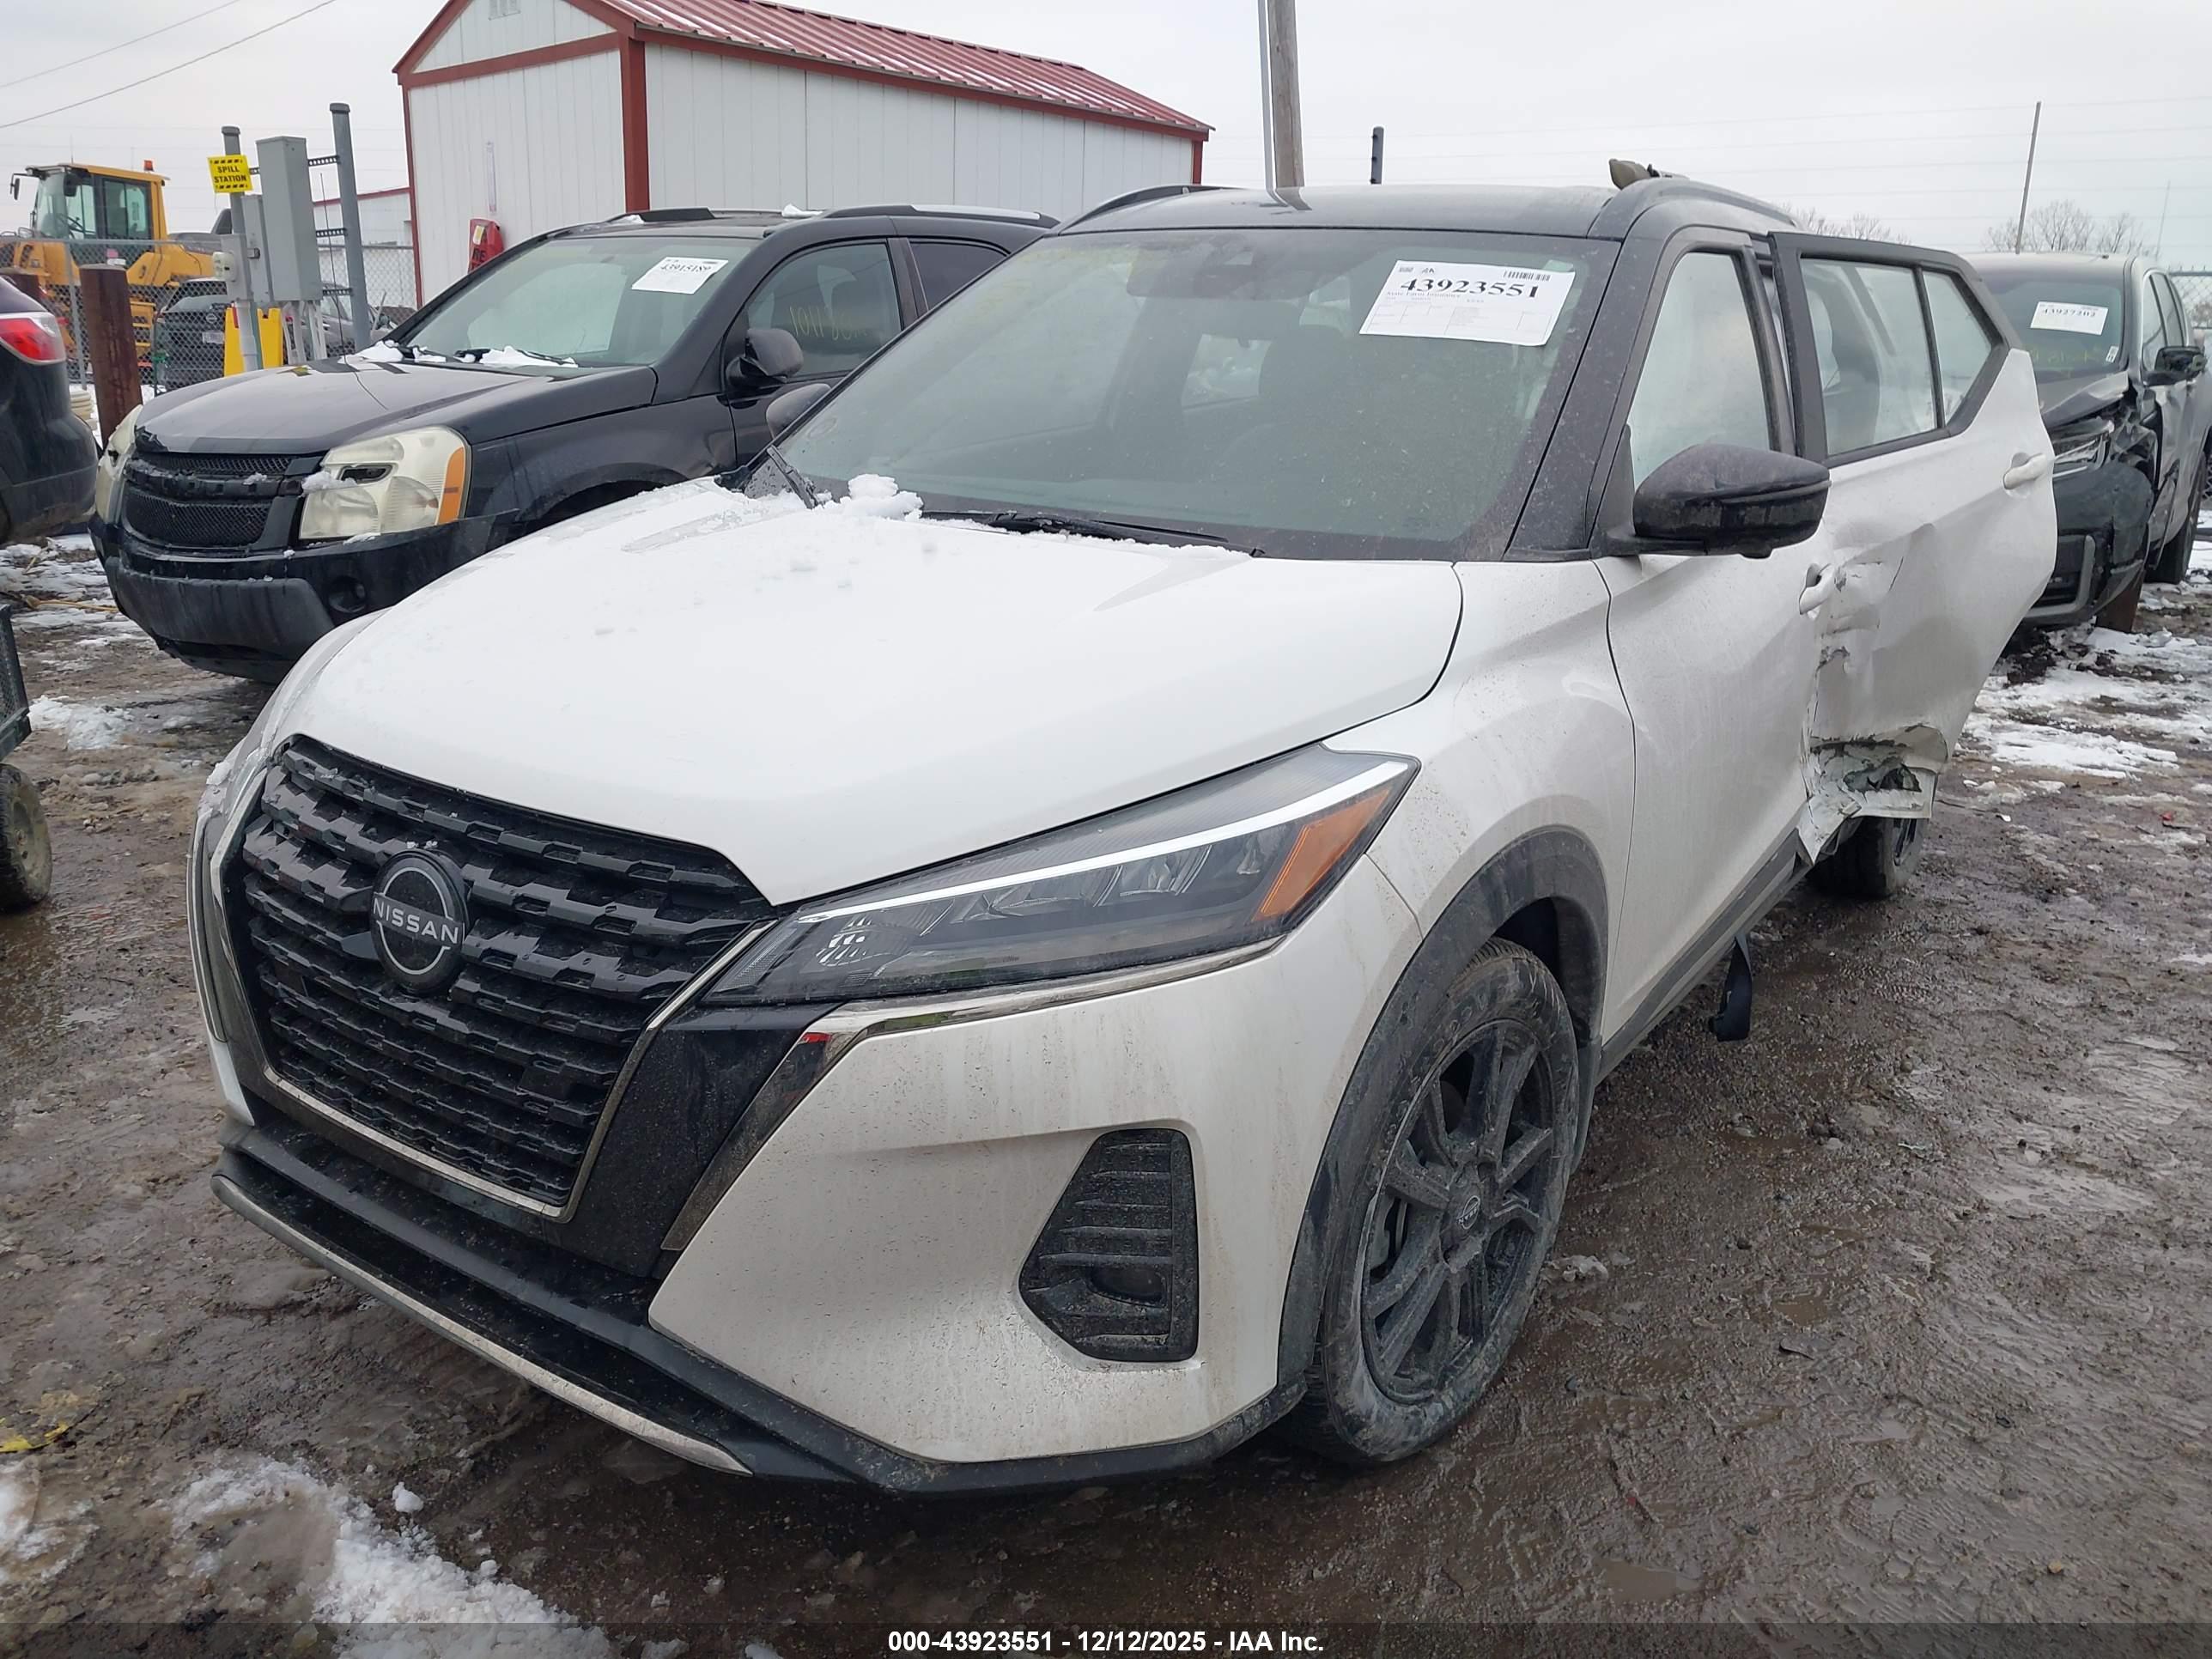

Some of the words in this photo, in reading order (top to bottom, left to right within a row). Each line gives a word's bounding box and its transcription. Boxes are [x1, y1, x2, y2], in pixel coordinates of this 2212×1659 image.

[217, 165, 240, 173] SPILL
[214, 174, 247, 183] STATION
[1401, 276, 1540, 298] 43923551
[373, 897, 459, 945] NISSAN
